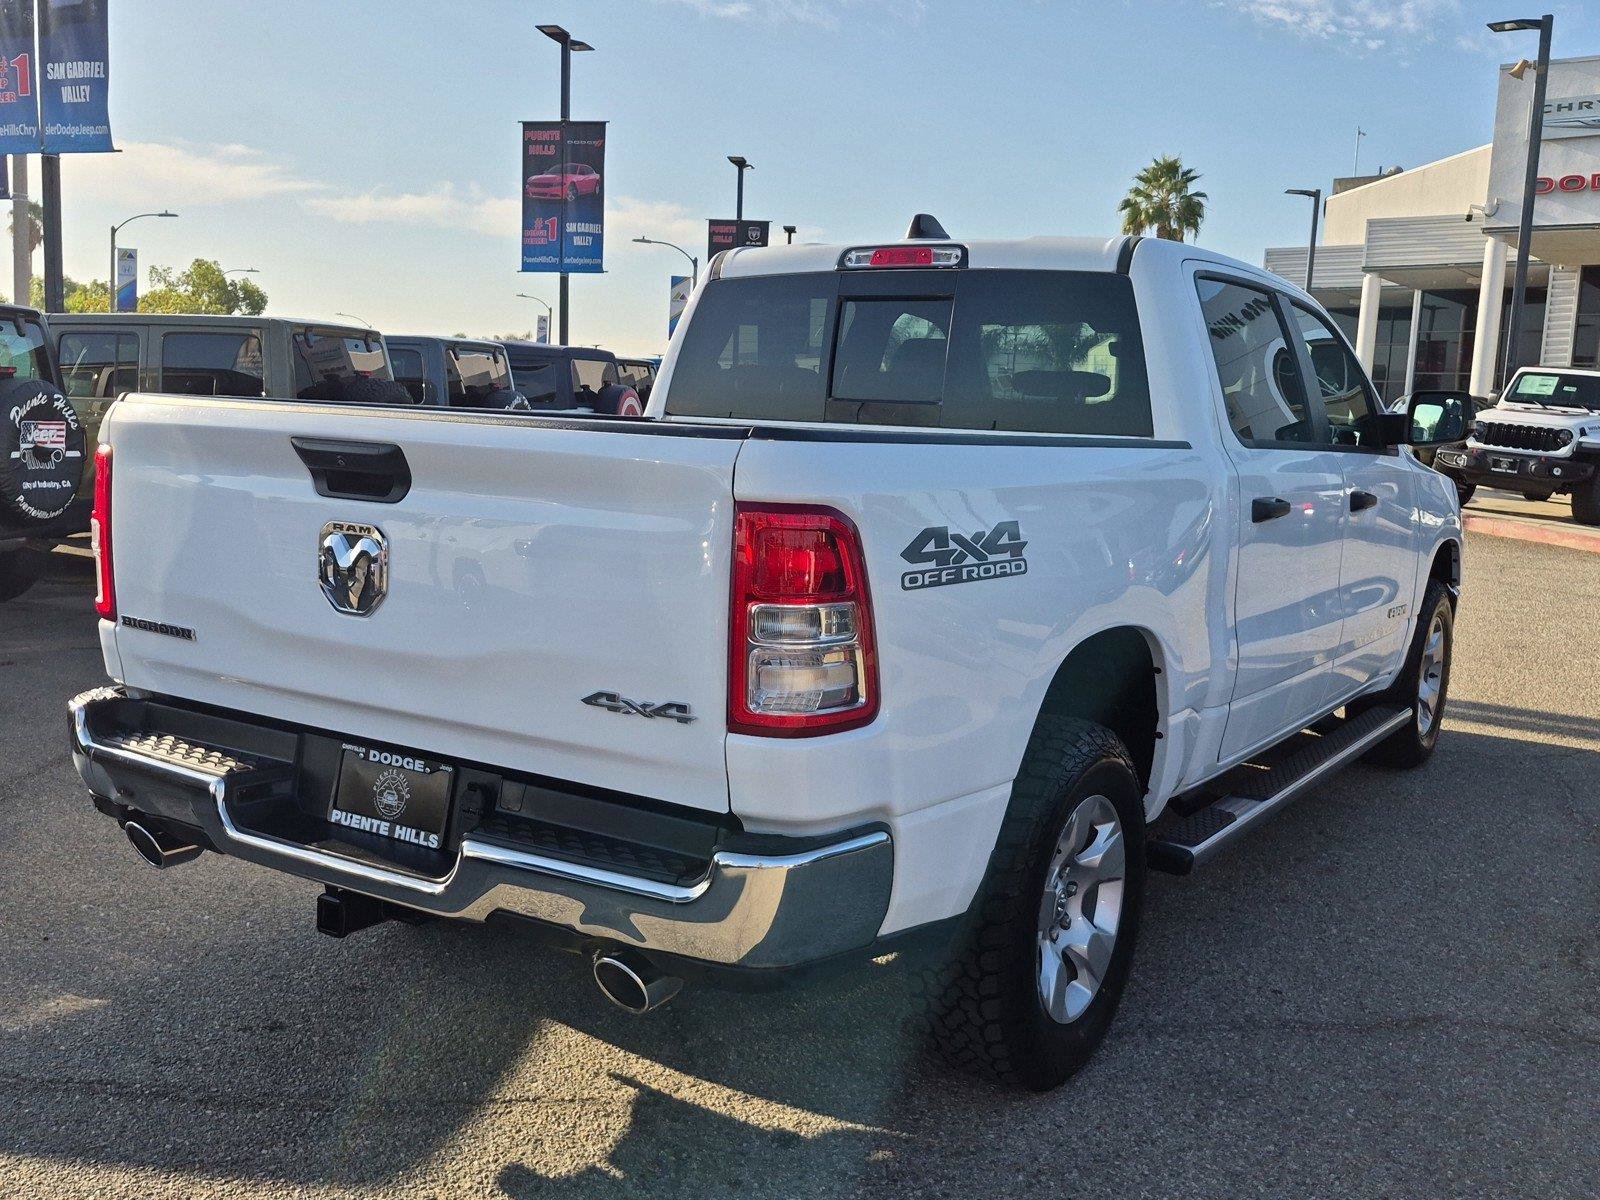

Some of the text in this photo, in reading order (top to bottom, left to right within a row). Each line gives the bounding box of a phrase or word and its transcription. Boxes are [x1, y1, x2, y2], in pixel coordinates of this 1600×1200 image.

[46, 61, 105, 80] SAN GABRIEL
[61, 85, 91, 104] VALLEY
[1543, 100, 1600, 114] CHR
[0, 123, 37, 138] eHillsChry
[524, 130, 560, 141] PUENTE
[528, 144, 556, 155] HILLS
[565, 222, 602, 234] SAN GABRIEL
[573, 235, 593, 246] VALLEY
[9, 391, 78, 430] Puente Hills
[26, 424, 58, 442] Jeep
[61, 480, 72, 488] CA
[332, 523, 372, 534] RAM
[903, 560, 1026, 588] OFF ROAD
[368, 749, 425, 773] DODGE
[439, 764, 453, 773] Jeep
[330, 809, 391, 836] PUENTE
[393, 824, 440, 849] HILLS
